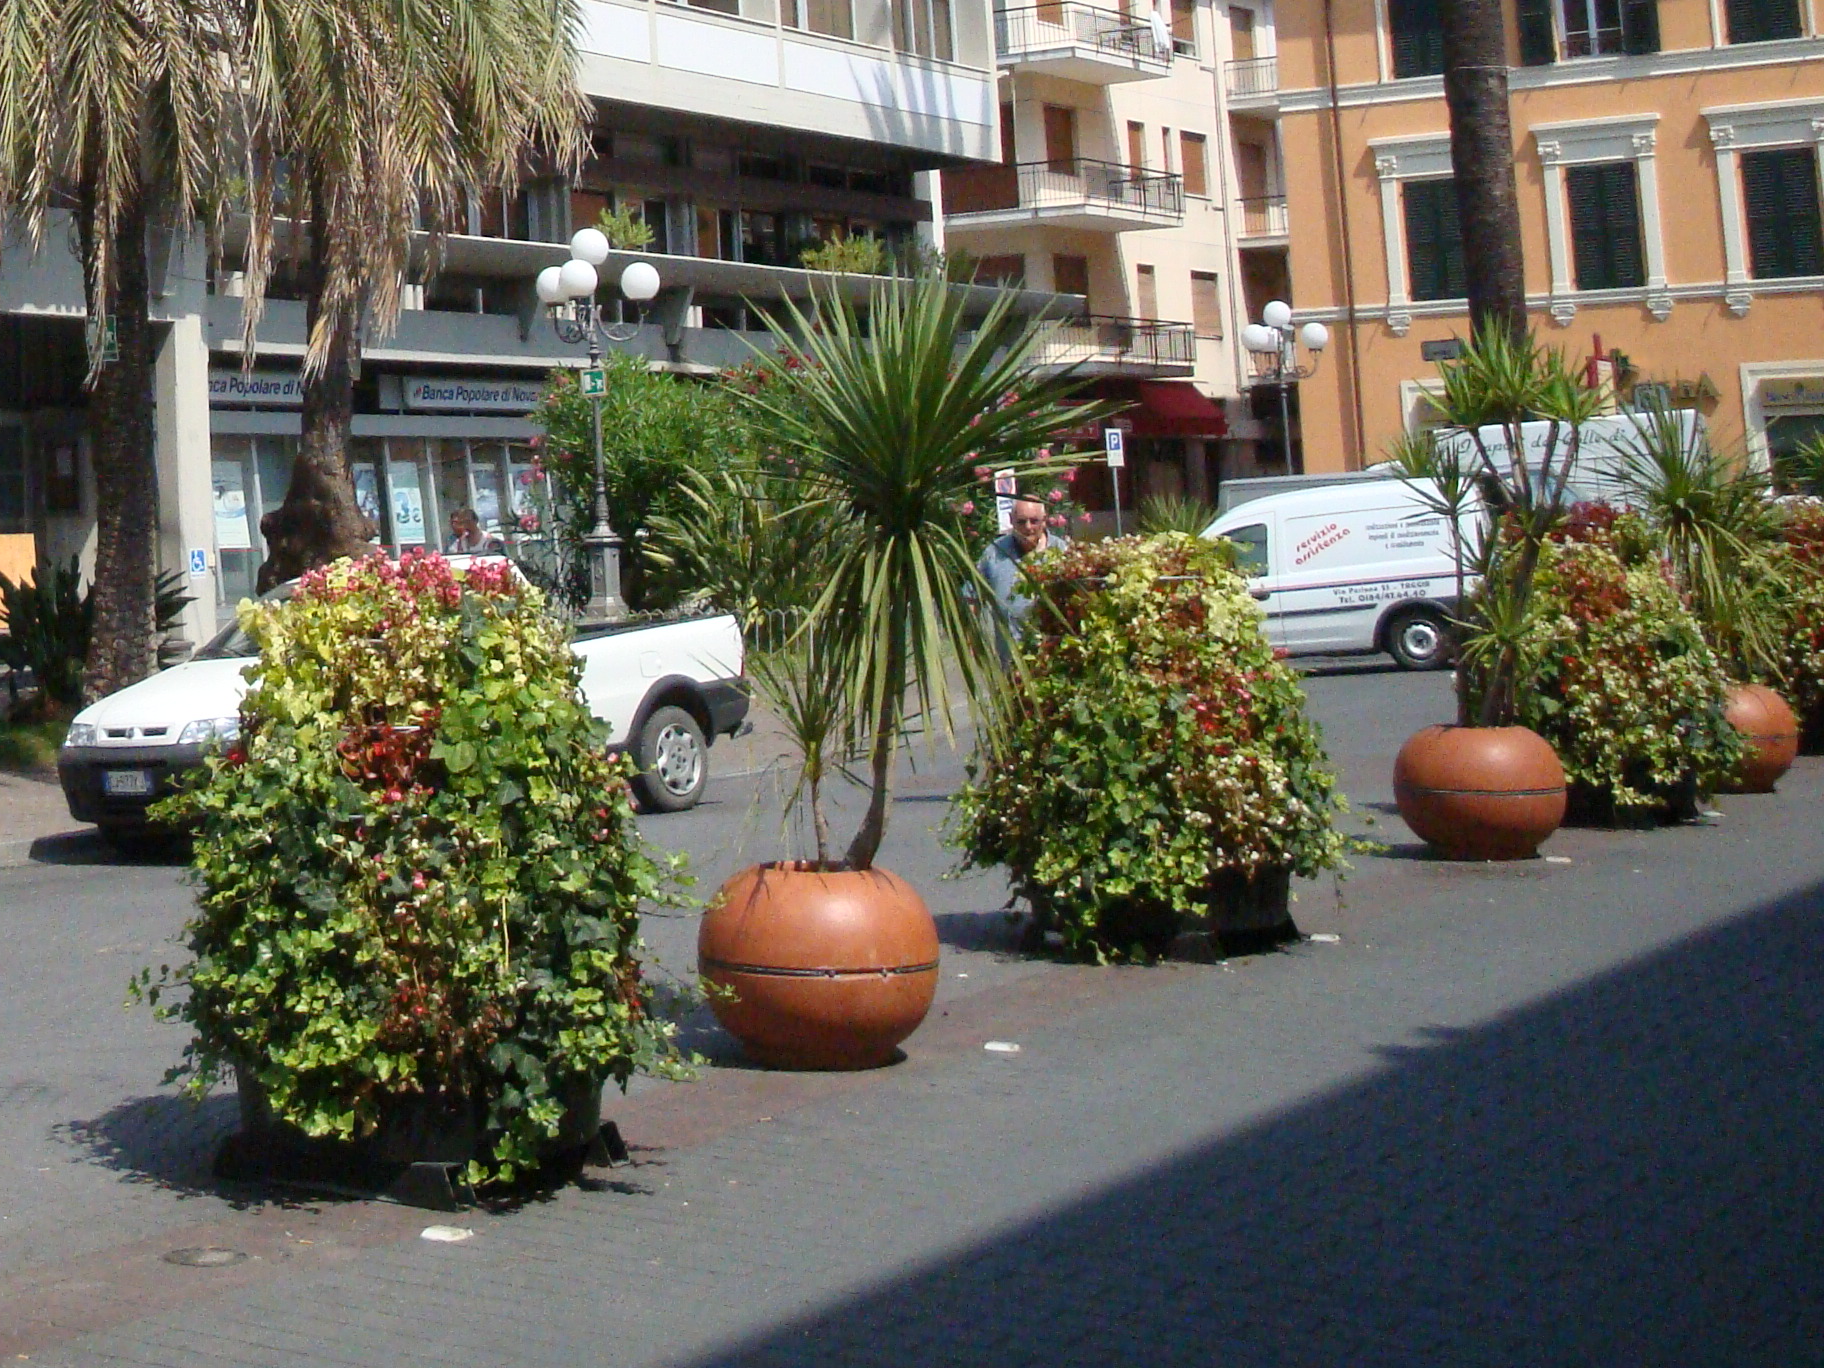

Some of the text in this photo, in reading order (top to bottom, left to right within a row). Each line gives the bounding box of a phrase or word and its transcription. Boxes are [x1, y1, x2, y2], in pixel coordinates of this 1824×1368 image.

[229, 377, 281, 397] Popolare
[283, 380, 294, 395] di
[422, 385, 538, 404] Banca Popolare di Nova
[1110, 434, 1119, 449] P
[1295, 528, 1351, 565] assistenza
[1296, 523, 1337, 553] servizio
